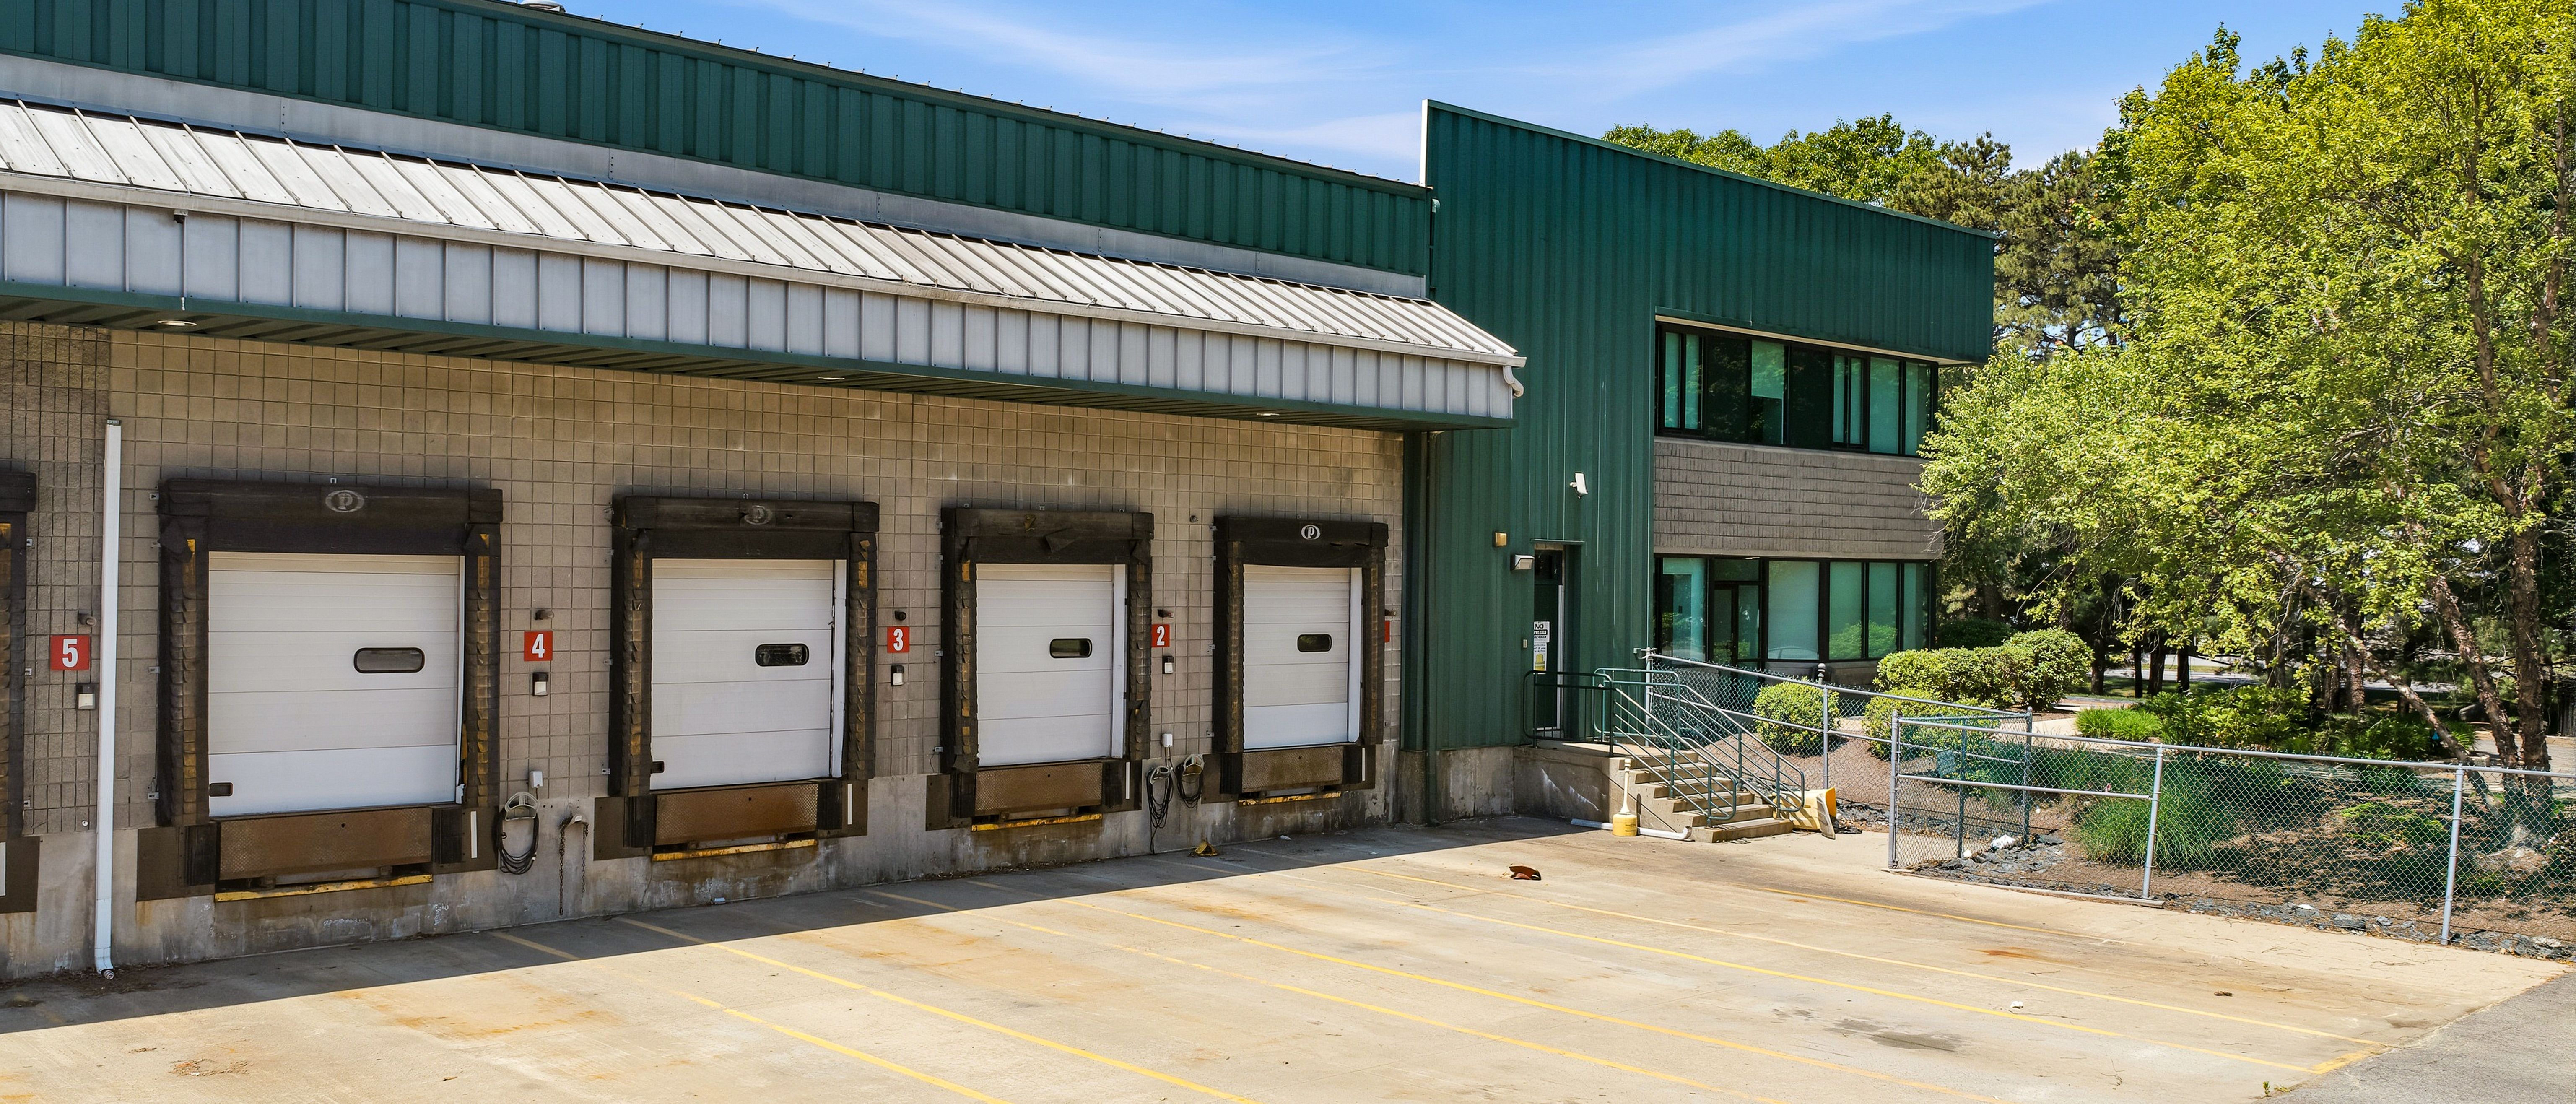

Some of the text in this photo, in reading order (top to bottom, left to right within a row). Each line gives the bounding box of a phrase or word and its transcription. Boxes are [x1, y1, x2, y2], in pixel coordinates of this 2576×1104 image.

[532, 634, 545, 658] 4
[893, 629, 904, 651] 3
[1157, 626, 1165, 645] 2
[62, 638, 78, 668] 5
